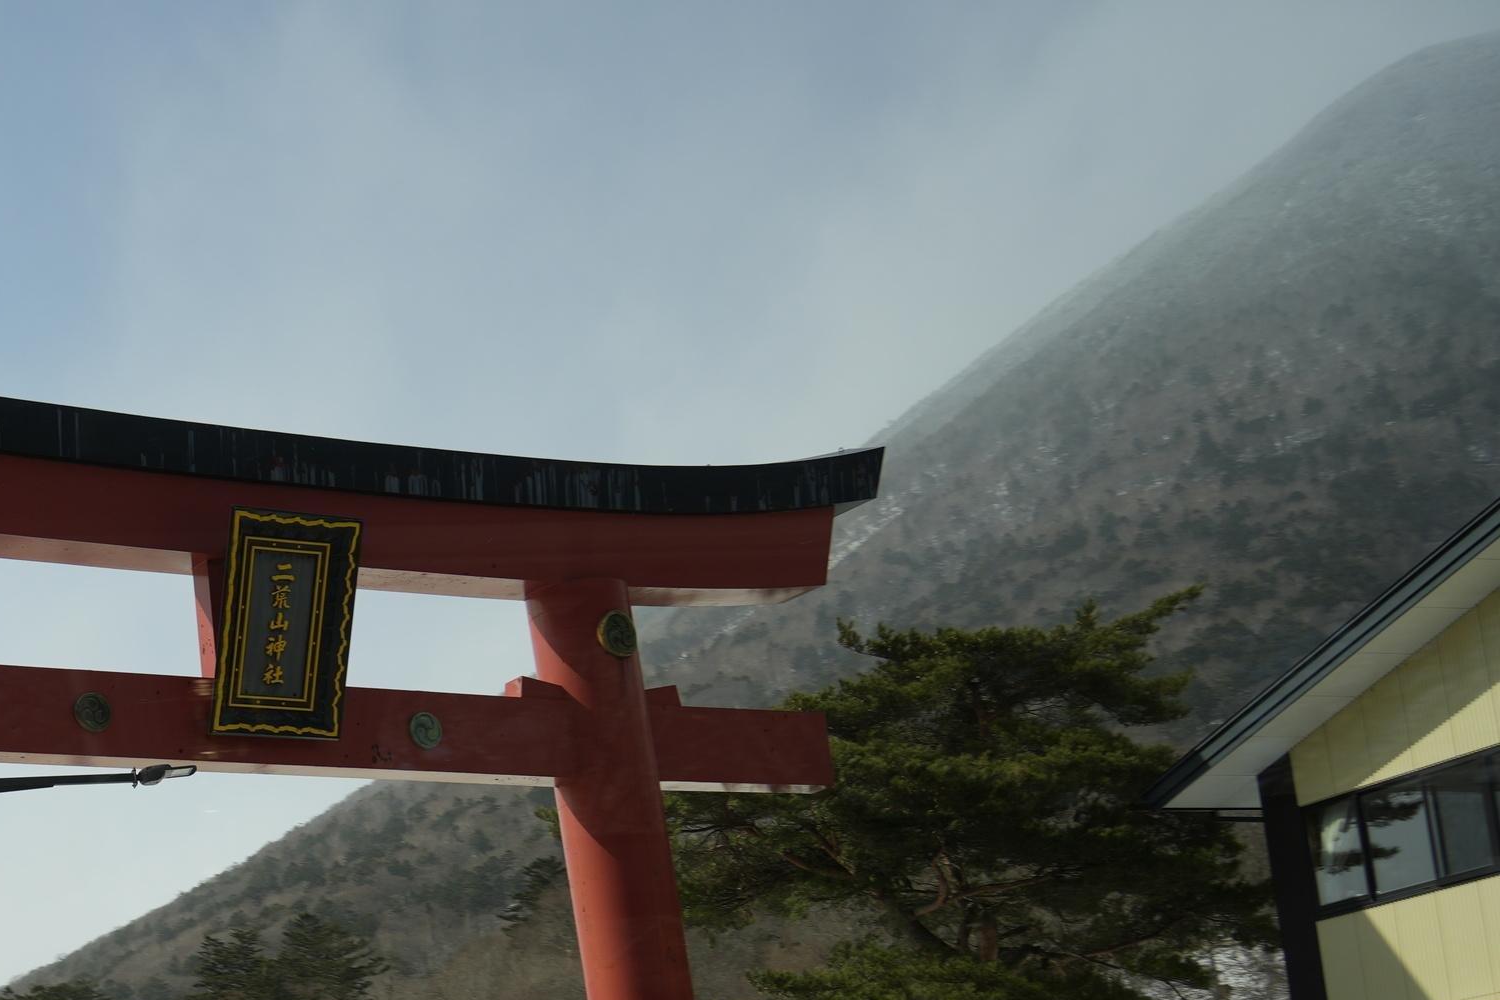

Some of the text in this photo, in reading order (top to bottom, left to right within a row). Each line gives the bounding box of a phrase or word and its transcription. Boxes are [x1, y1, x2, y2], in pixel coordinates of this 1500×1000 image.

[262, 563, 295, 685] 二荒山神社
